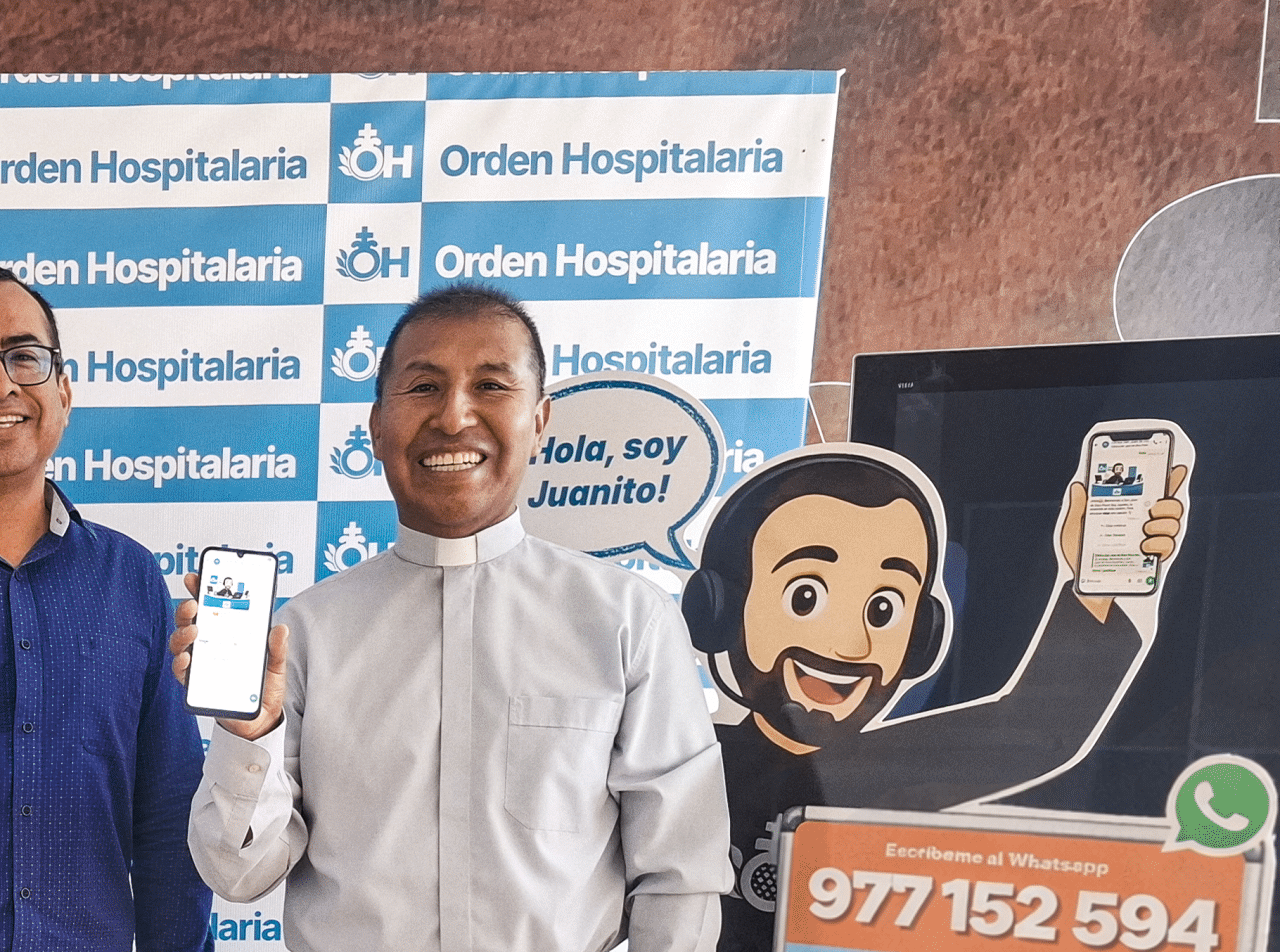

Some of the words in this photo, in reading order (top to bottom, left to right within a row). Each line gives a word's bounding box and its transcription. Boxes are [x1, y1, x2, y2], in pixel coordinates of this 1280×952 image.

[91, 147, 307, 190] Hospitalaria
[440, 143, 552, 177] Orden
[562, 138, 784, 182] Hospitalaria
[87, 246, 302, 290] Hospitalaria
[435, 244, 546, 279] Orden
[555, 240, 777, 285] Hospitalaria
[88, 346, 301, 391] Hospitalaria
[552, 341, 772, 376] Hospitalaria
[84, 445, 297, 488] Hospitalaria
[528, 434, 614, 468] Hola,
[623, 435, 688, 466] soy
[528, 474, 671, 509] Juanito!
[987, 851, 1003, 866] al
[1009, 852, 1109, 877] Whatsapp
[808, 867, 934, 928] 977
[941, 878, 1060, 943] 152
